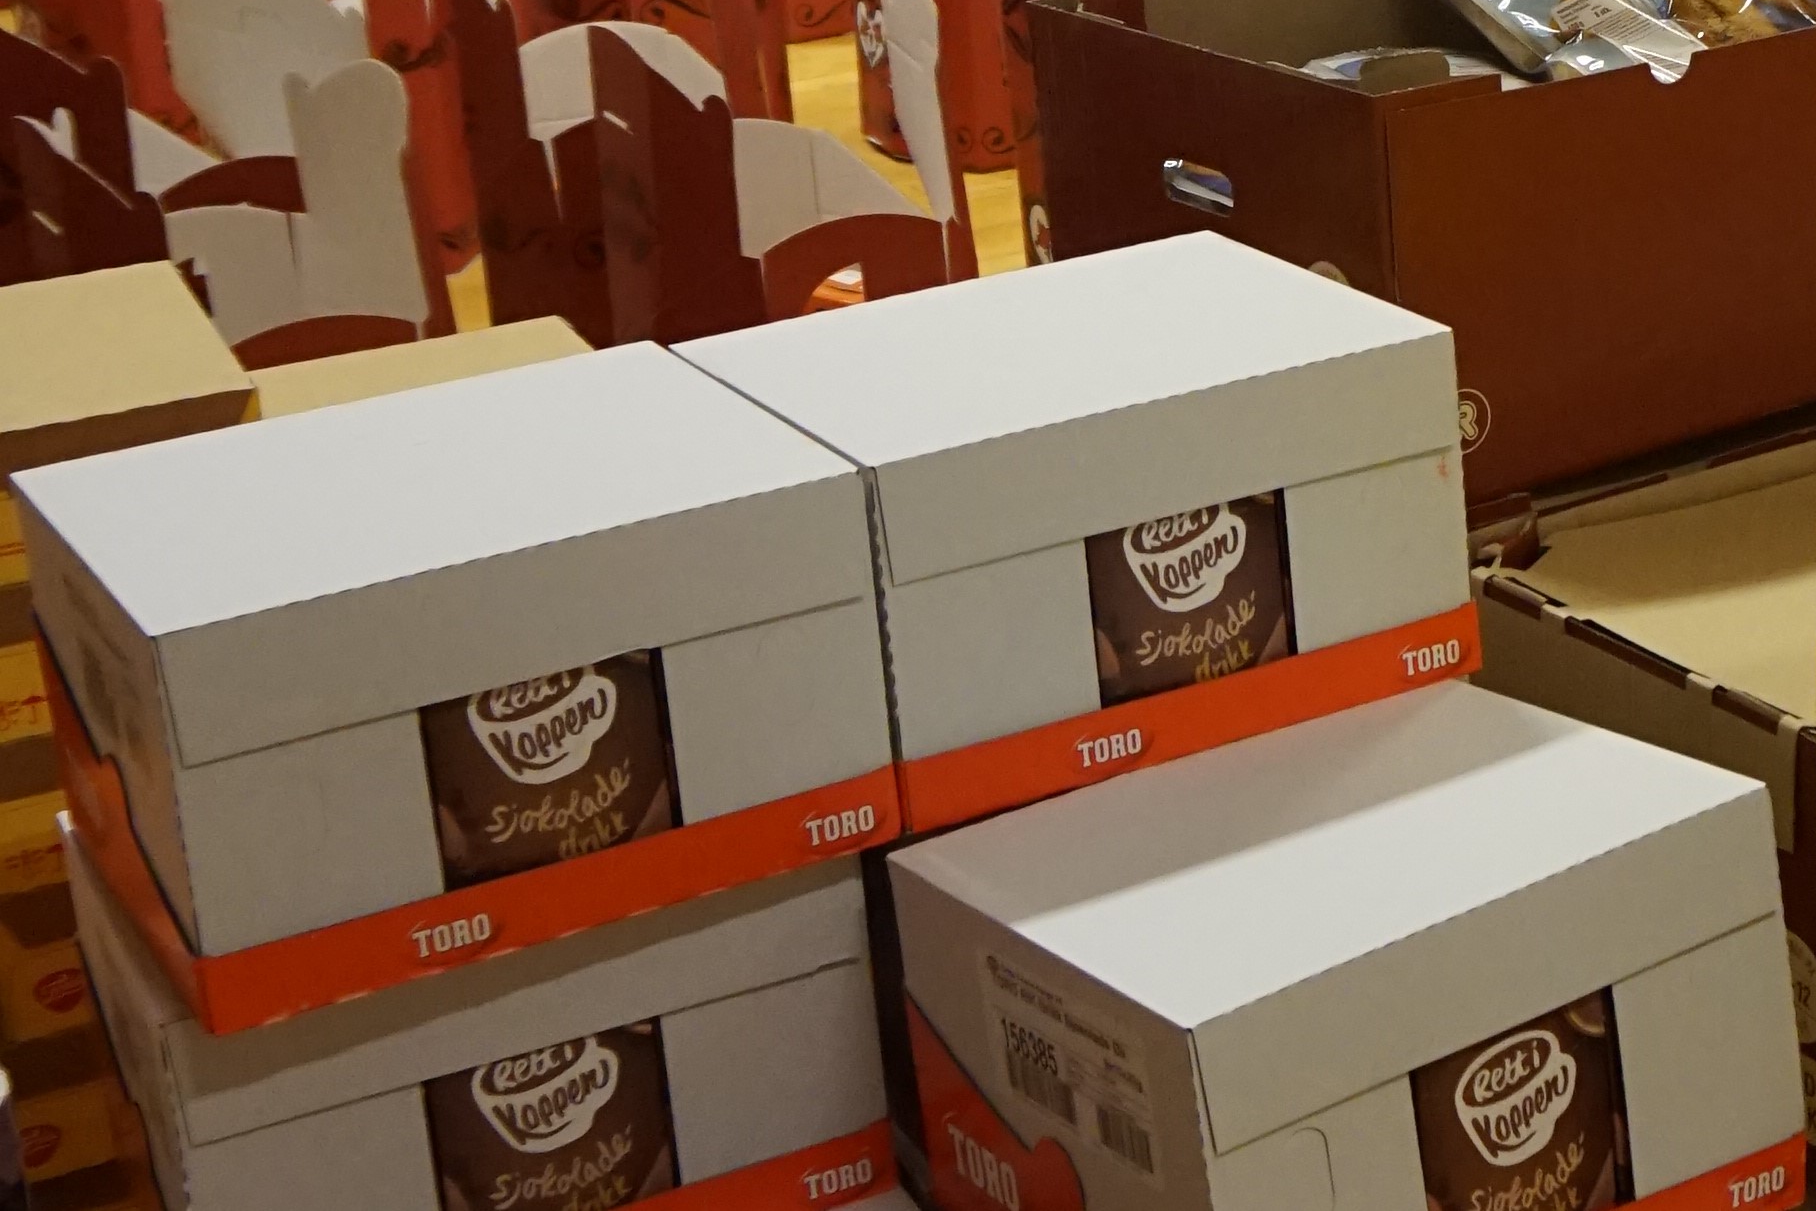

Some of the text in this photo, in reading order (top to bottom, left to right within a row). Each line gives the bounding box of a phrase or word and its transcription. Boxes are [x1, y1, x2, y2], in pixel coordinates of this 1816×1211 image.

[1402, 639, 1461, 676] TORO
[1077, 728, 1143, 768] TORO
[805, 804, 876, 846] TORO
[411, 913, 491, 958] TORO
[1002, 1018, 1058, 1076] 156385
[803, 1158, 872, 1200] TORO
[948, 1123, 1019, 1211] TORO
[1728, 1166, 1785, 1207] TORO
